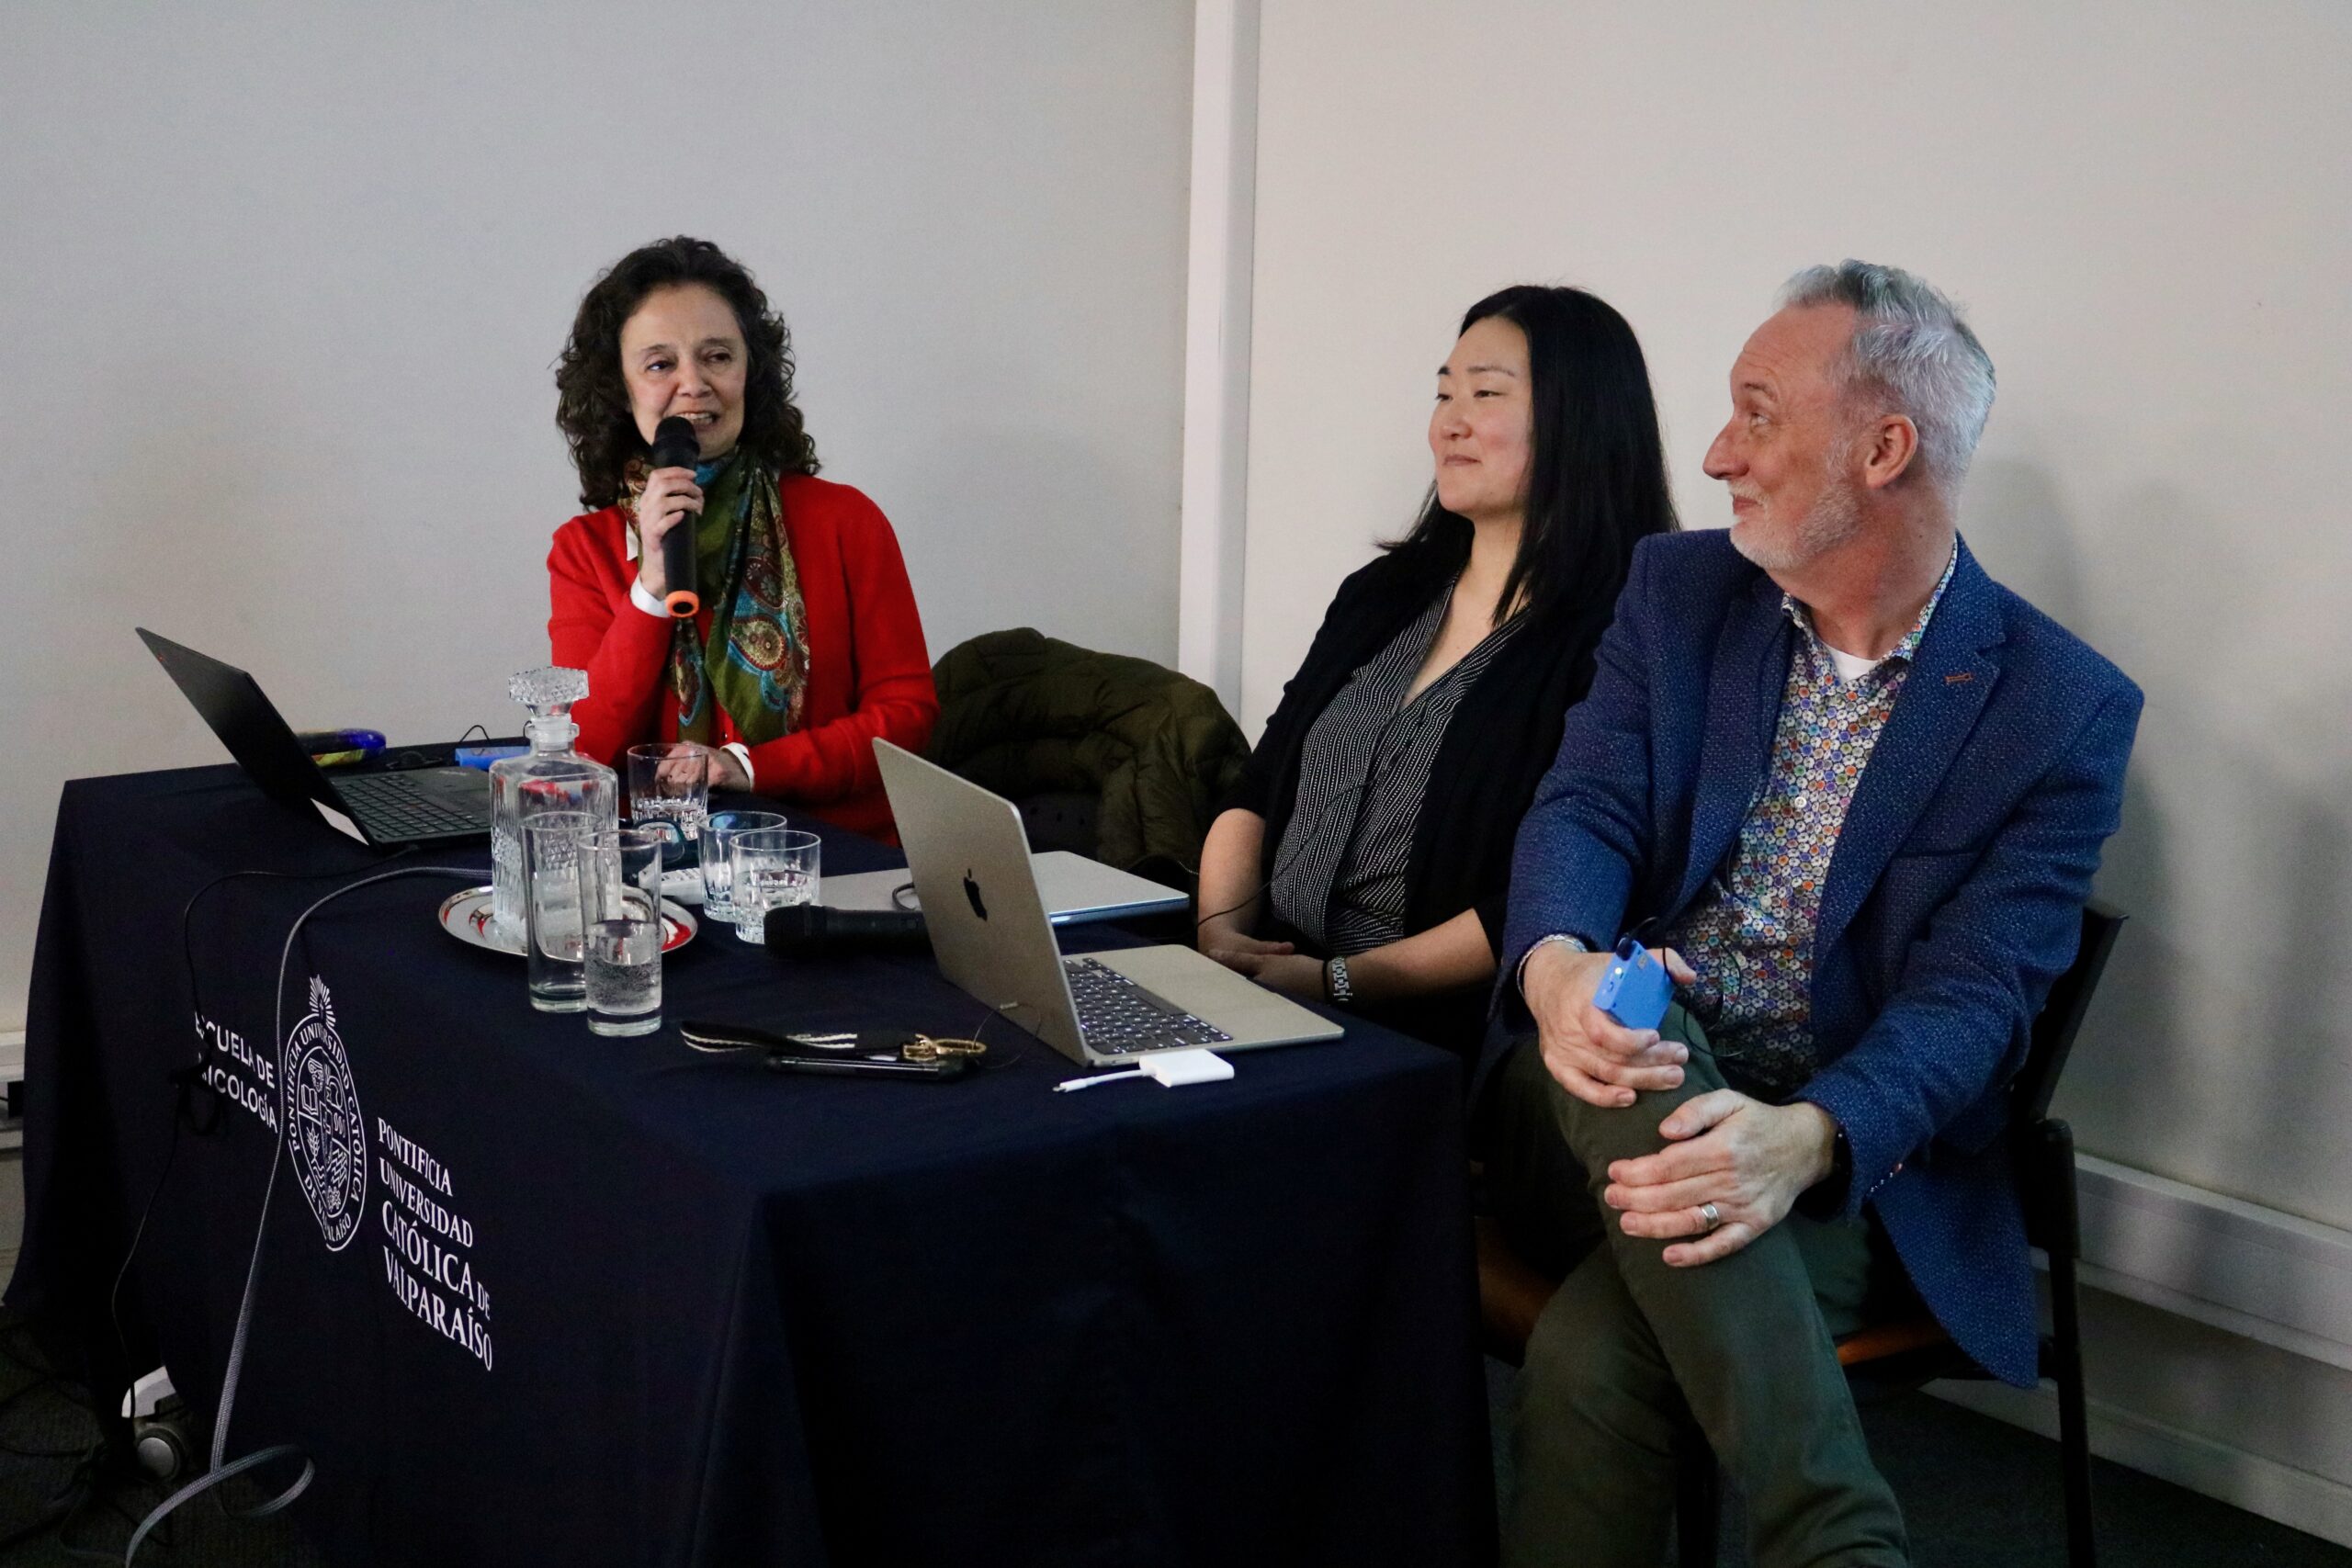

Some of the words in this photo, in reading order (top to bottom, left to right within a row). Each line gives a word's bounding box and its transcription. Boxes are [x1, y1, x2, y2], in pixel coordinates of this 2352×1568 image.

[256, 1054, 275, 1089] DE
[378, 1117, 453, 1196] PONTIFICIA
[379, 1156, 473, 1248] UNIVERSIDAD
[382, 1201, 474, 1302] CATÓLICA
[477, 1280, 491, 1321] DE
[383, 1245, 492, 1371] VALPARAÍSO
